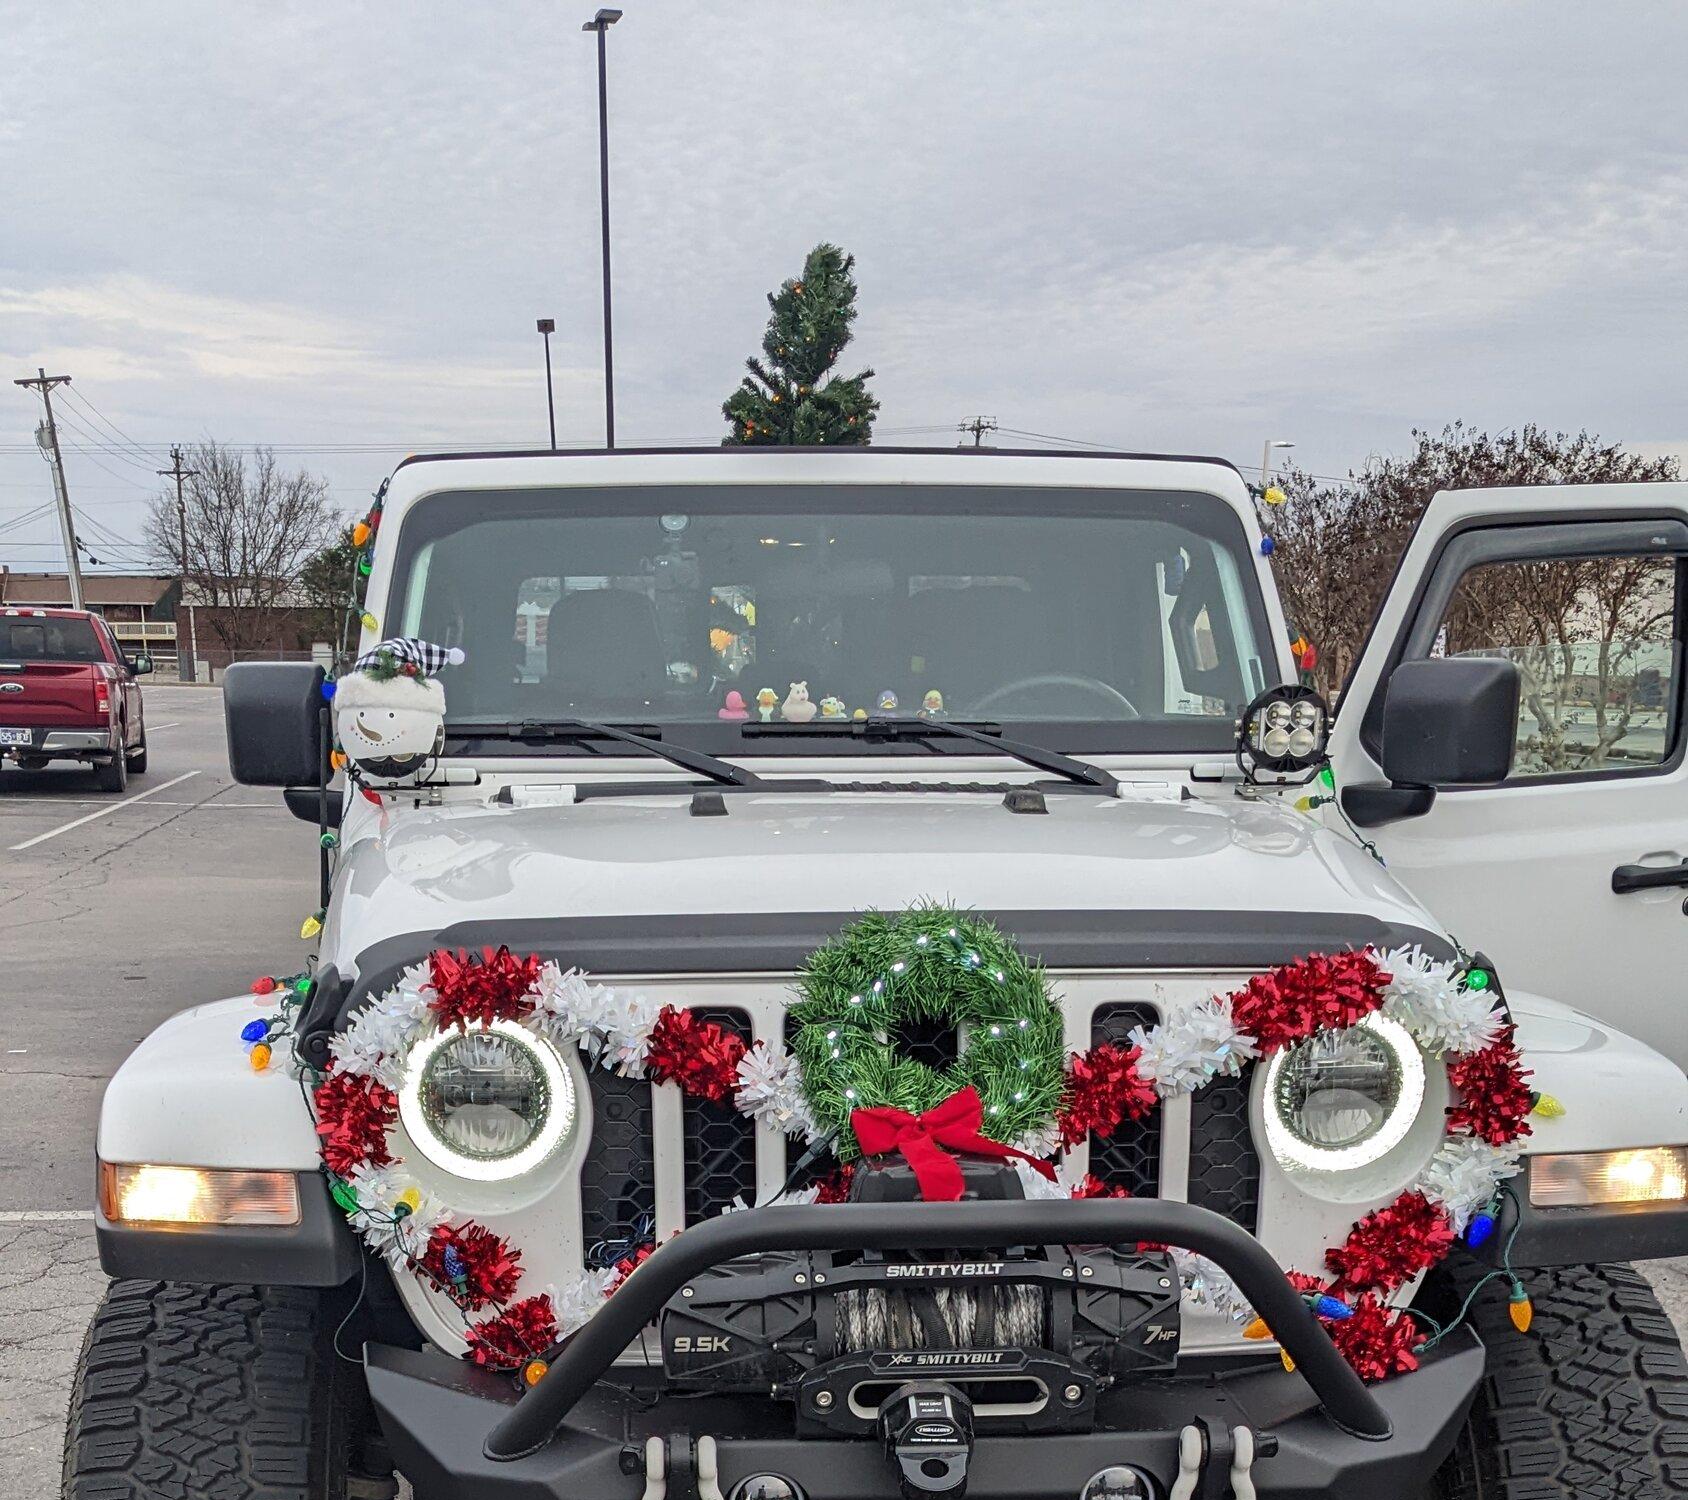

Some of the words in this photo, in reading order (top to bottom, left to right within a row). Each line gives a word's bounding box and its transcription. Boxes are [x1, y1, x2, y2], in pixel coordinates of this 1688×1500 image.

[886, 1263, 1004, 1277] SMITTYBILT
[674, 1336, 731, 1353] 9.5K
[916, 1353, 1003, 1365] SMITTYBILT
